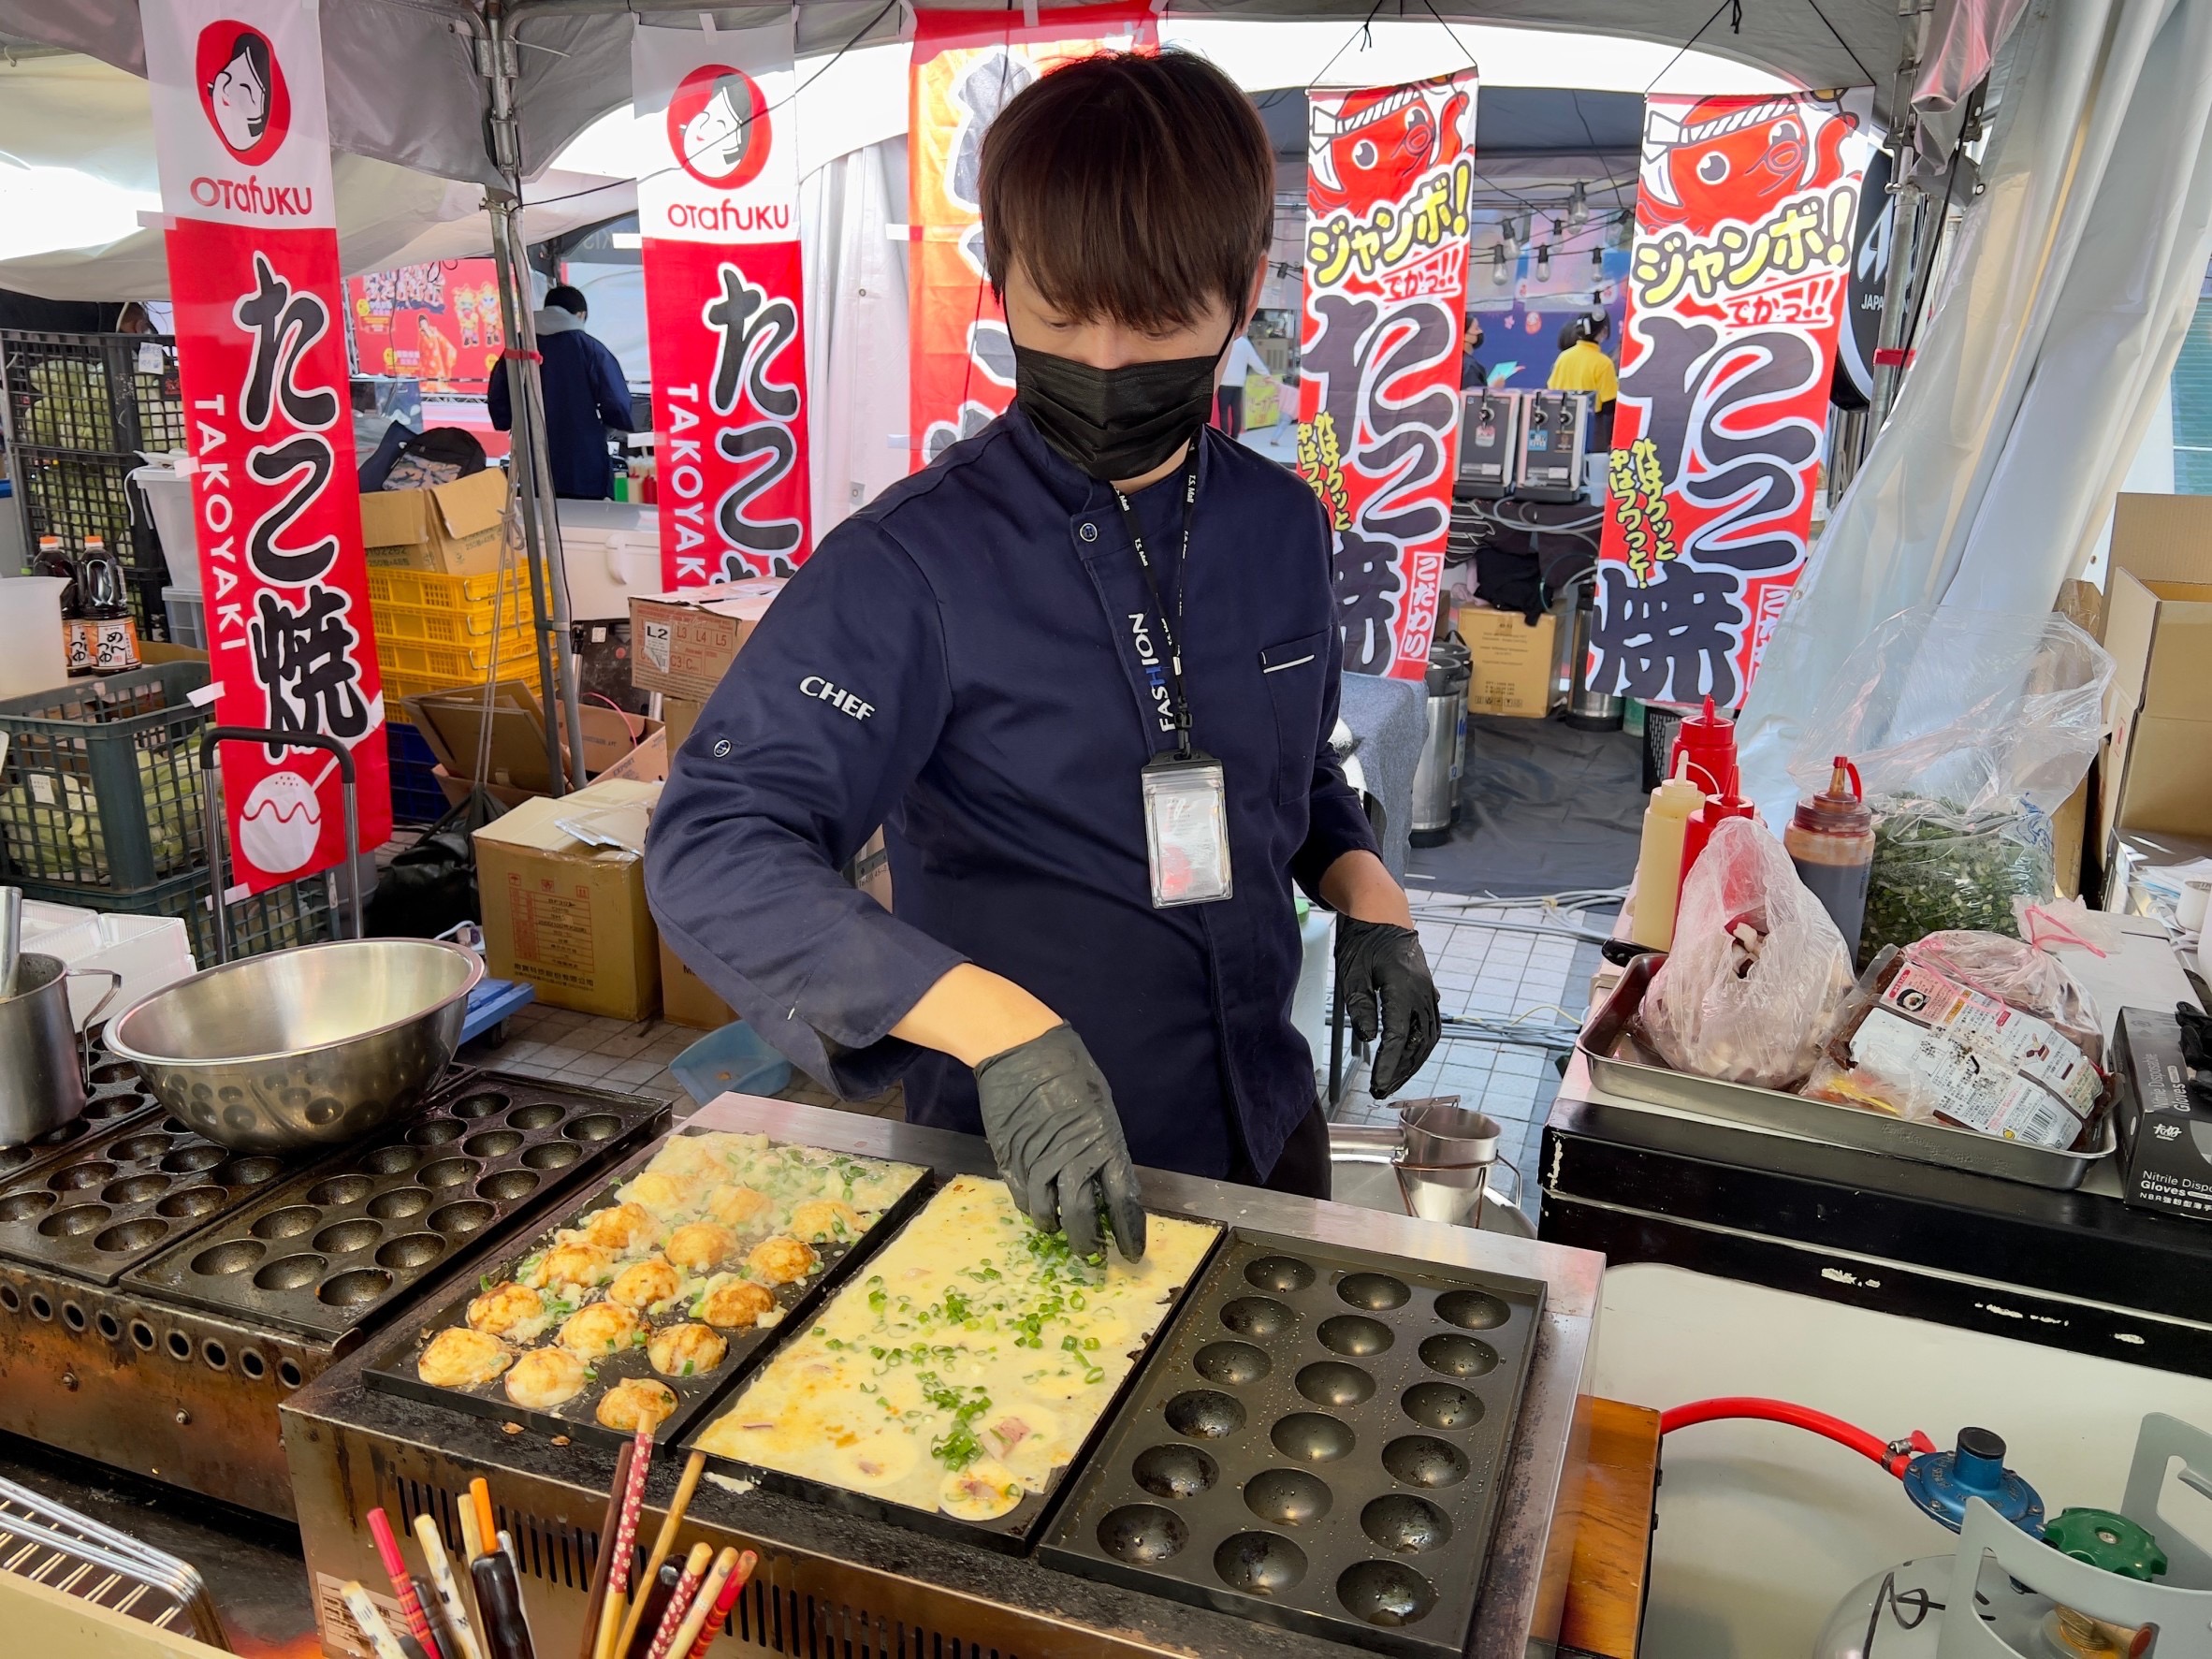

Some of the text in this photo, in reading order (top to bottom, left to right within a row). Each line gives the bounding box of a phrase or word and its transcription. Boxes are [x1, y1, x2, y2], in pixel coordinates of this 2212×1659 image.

[1308, 162, 1470, 286] ジャンボ!
[1634, 187, 1855, 307] ジャンボ!
[1860, 293, 1885, 311] JAPA
[703, 262, 803, 585] たこ
[666, 384, 707, 591] TAKOYAK
[195, 394, 247, 651] TAKOYAKI
[234, 251, 374, 764] たこ焼
[1404, 556, 1437, 658] こだわり
[107, 632, 126, 654] めん
[647, 625, 669, 641] L2
[677, 624, 688, 639] L3
[696, 629, 707, 644] L4
[715, 633, 728, 647] L5
[96, 643, 112, 664] つゆ
[1128, 613, 1176, 732] FASHION
[799, 676, 876, 720] CHEF
[2153, 1087, 2170, 1111] Nitrile
[2174, 1083, 2190, 1113] Gloves
[2140, 1180, 2187, 1196] Gloves
[2143, 1170, 2178, 1186] Nitrile
